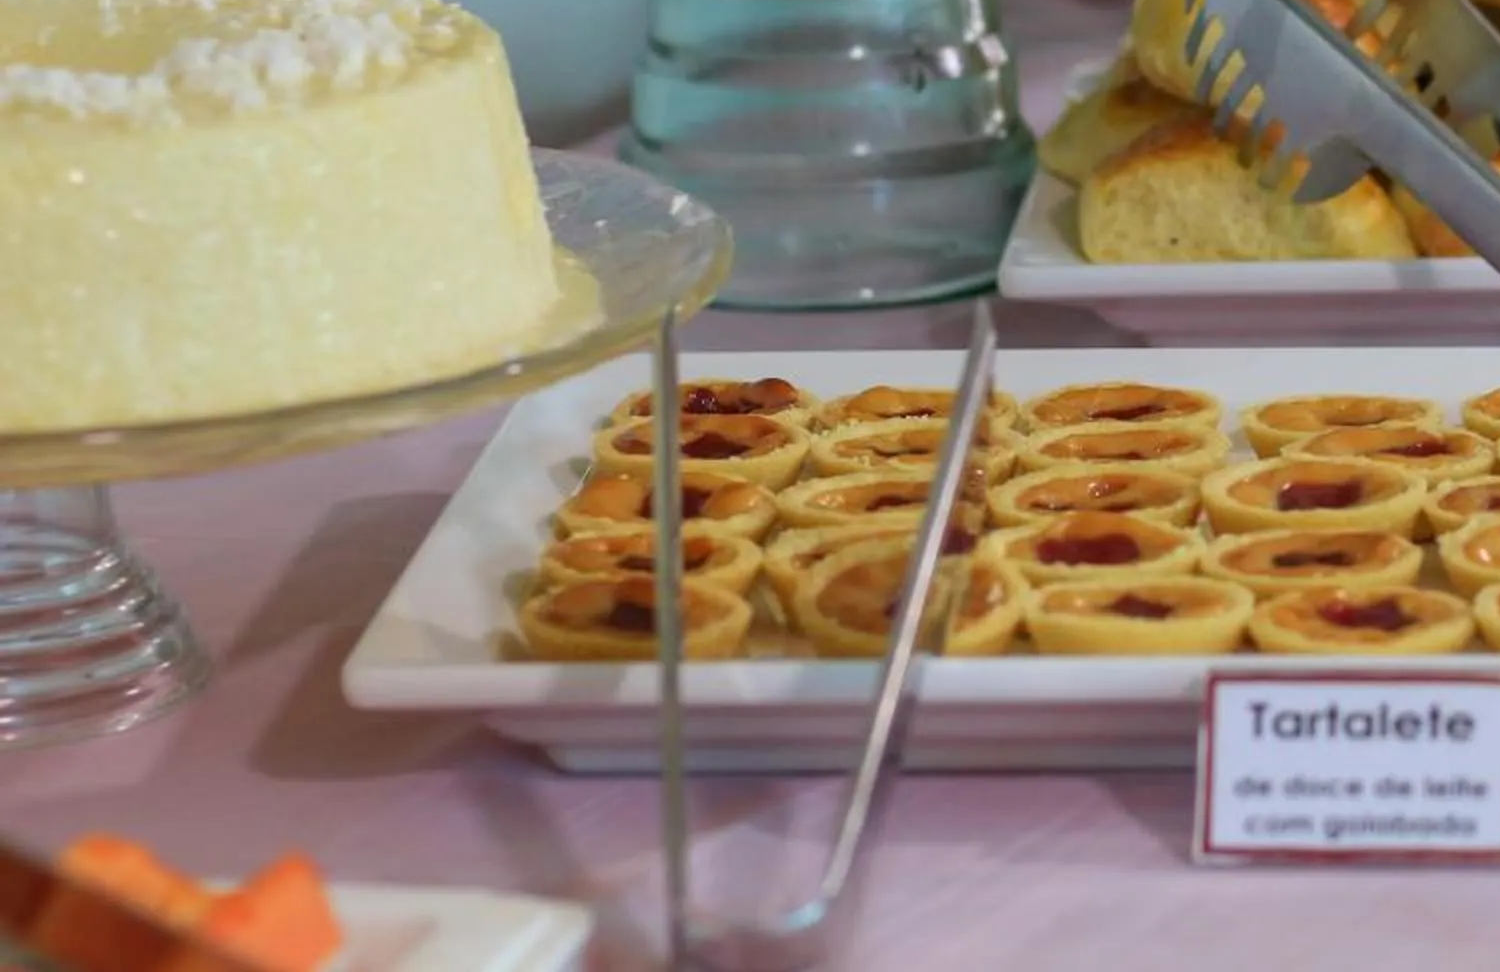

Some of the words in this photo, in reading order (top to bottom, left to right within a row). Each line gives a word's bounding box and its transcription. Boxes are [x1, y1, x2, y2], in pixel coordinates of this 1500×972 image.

[1249, 702, 1476, 740] Tartalete
[1233, 775, 1272, 798] de
[1283, 775, 1364, 798] doce
[1373, 775, 1413, 798] de
[1423, 775, 1488, 798] leite
[1243, 816, 1314, 837] com
